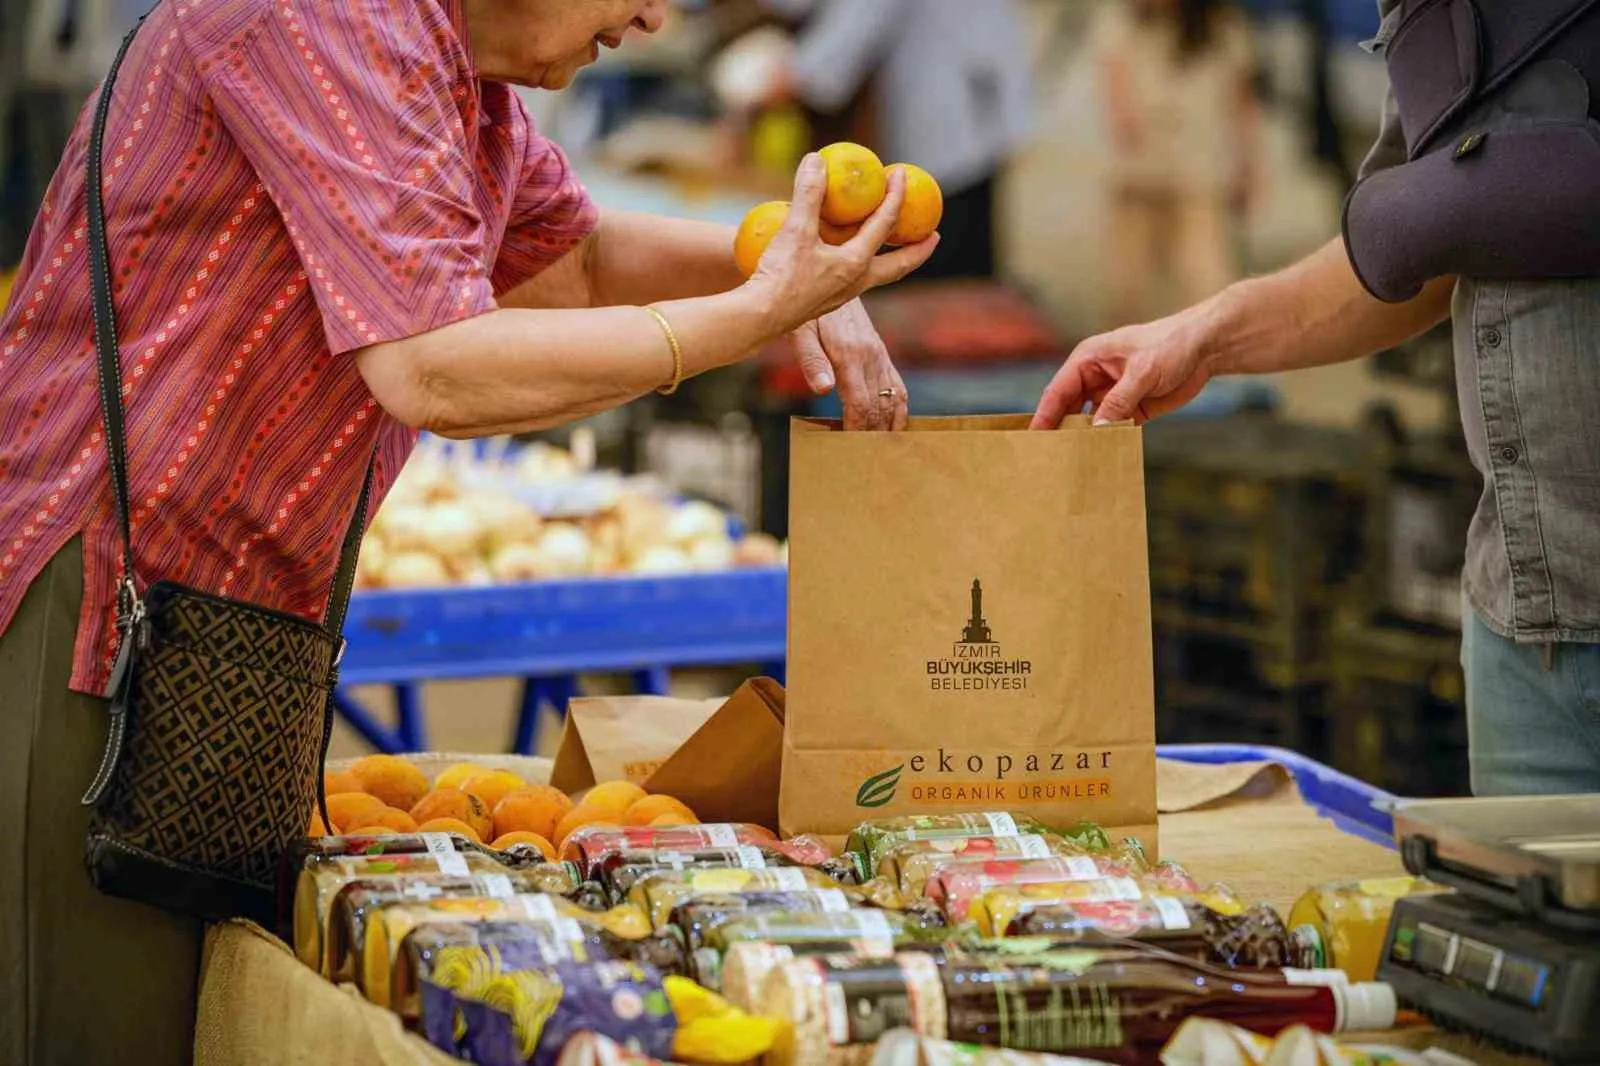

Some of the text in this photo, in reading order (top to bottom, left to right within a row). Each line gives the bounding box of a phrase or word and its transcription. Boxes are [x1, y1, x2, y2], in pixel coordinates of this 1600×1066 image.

[952, 643, 1001, 658] İZMİR
[926, 657, 1032, 676] BÜYÜKŞEHİR
[931, 676, 1027, 690] BELEDİYESİ
[910, 748, 1112, 779] ekopazar
[911, 782, 1110, 800] ORGANİK ÜRÜNLER
